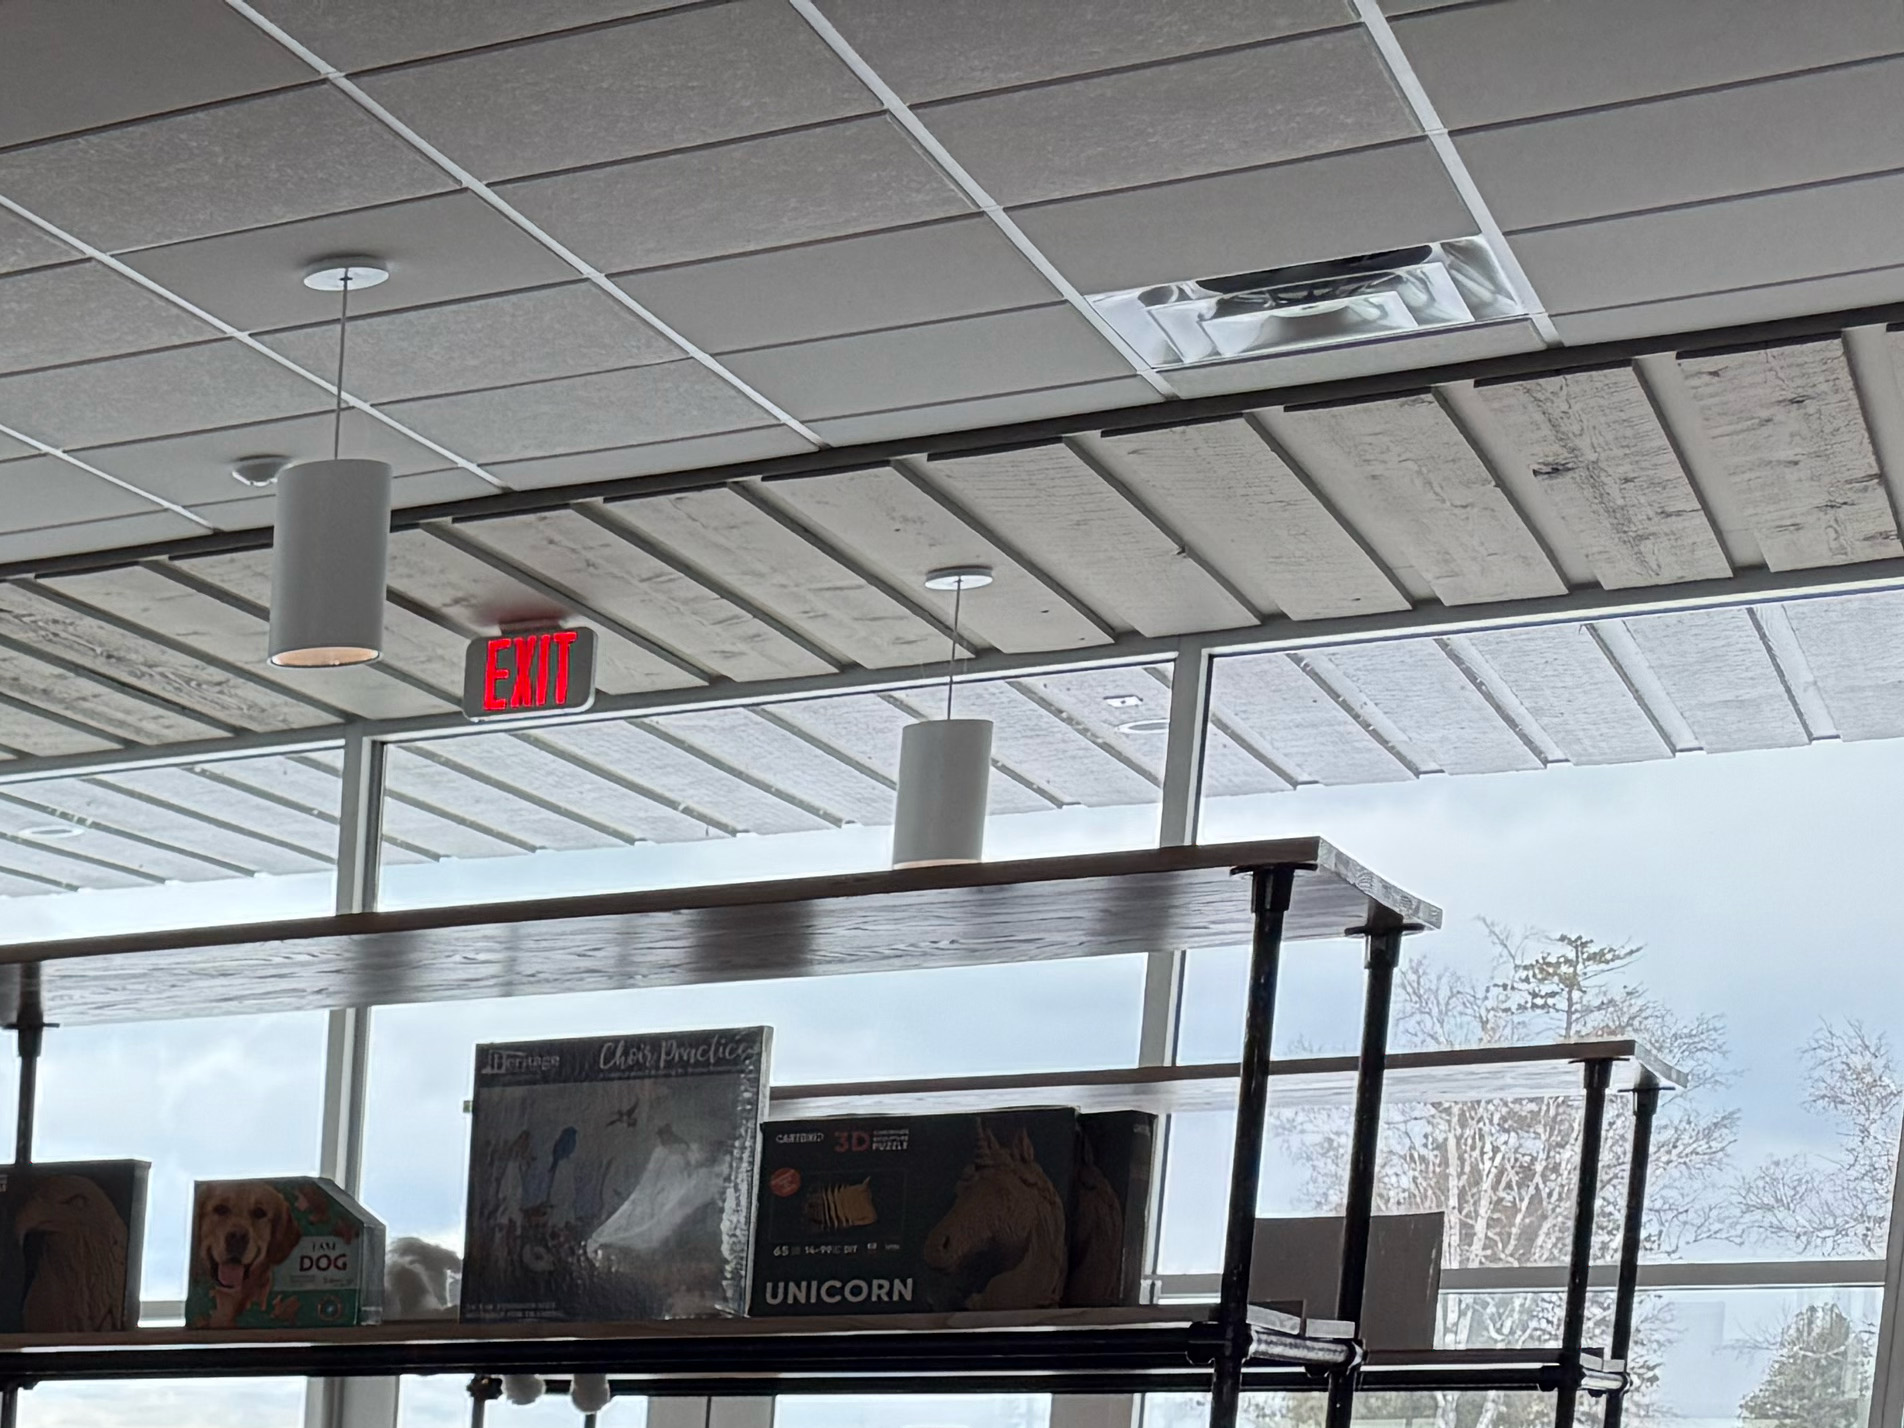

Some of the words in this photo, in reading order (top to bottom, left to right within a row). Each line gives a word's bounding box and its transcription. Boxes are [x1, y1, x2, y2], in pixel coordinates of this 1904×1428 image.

[483, 632, 578, 711] EXIT
[481, 1050, 560, 1075] Heritage
[599, 1040, 658, 1070] Choir
[833, 1131, 871, 1152] 3D
[872, 1141, 908, 1151] PUZZLE
[299, 1253, 347, 1272] DOG
[773, 1245, 789, 1257] 65
[765, 1277, 913, 1306] UNICORN
